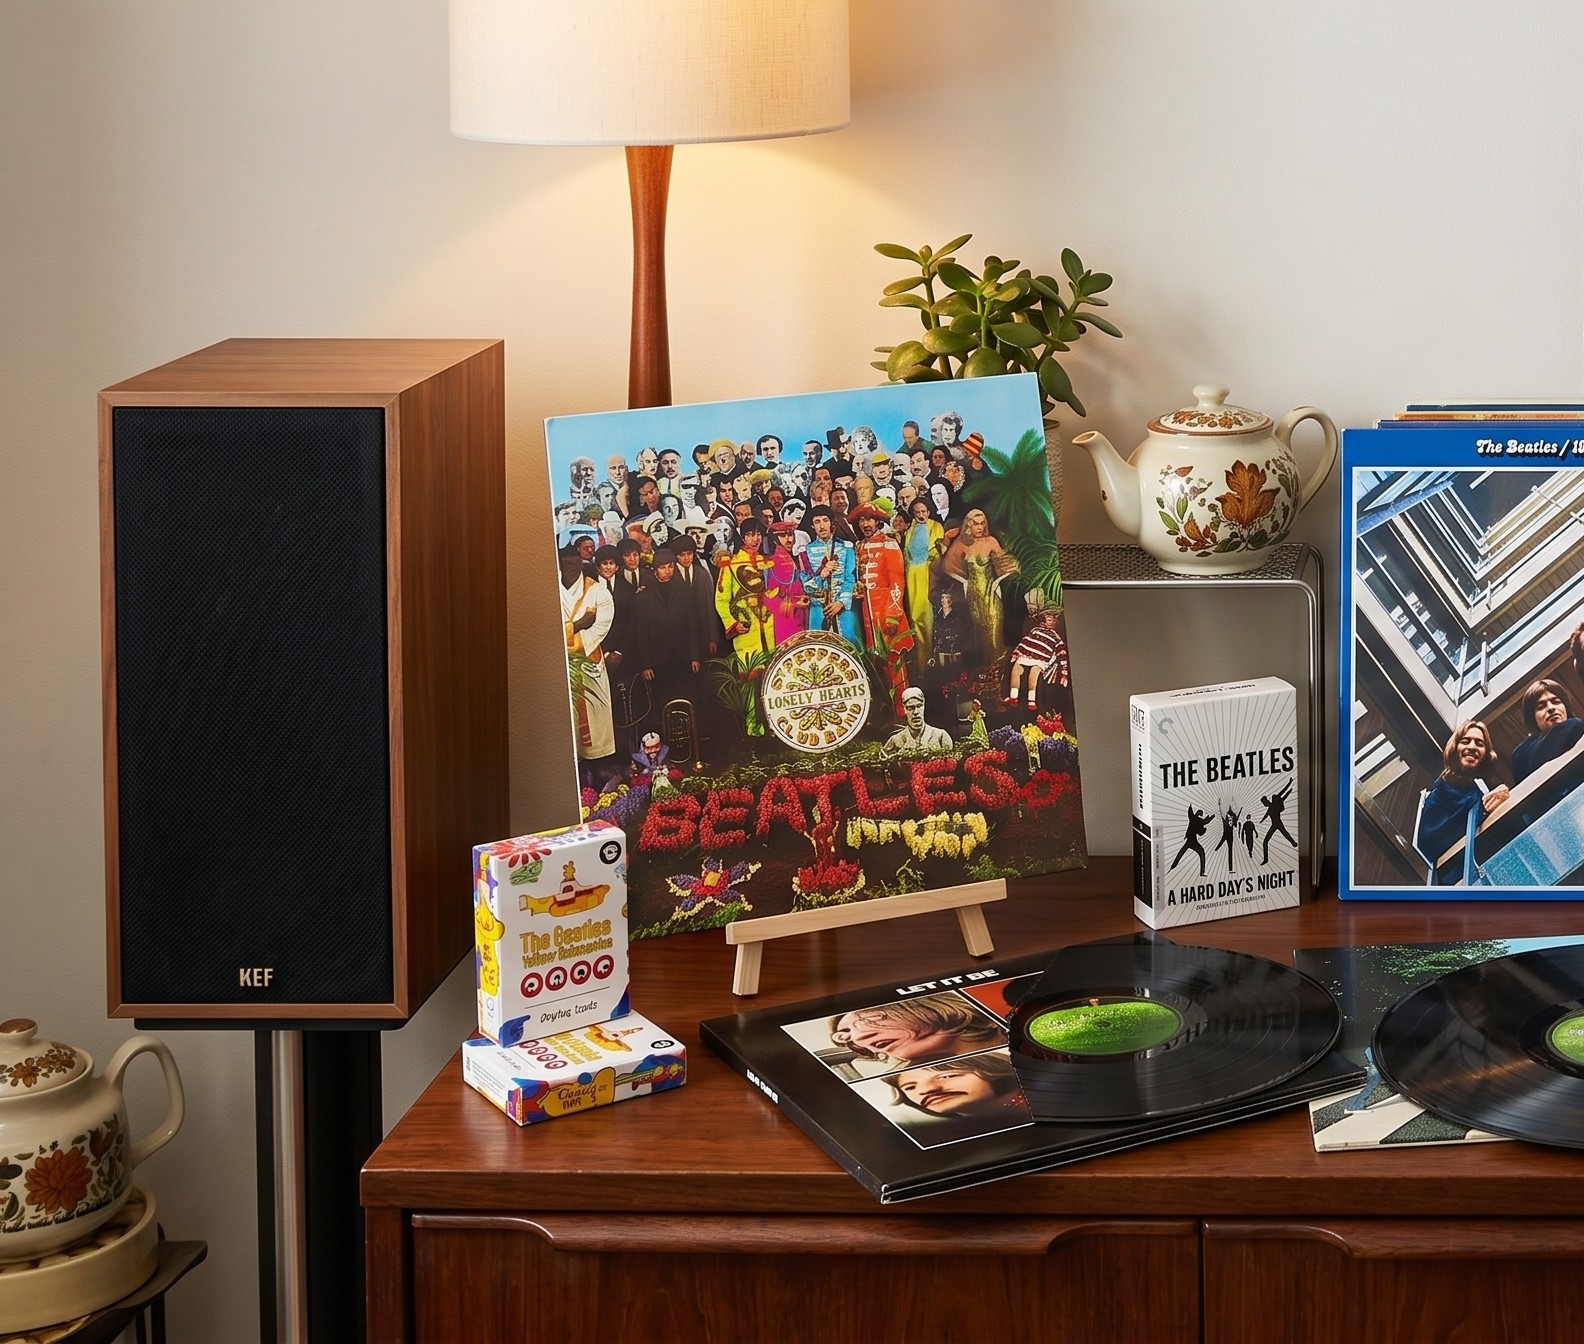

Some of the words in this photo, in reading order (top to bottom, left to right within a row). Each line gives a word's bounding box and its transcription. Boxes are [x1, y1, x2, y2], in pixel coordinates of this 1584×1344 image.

[1476, 439, 1502, 454] The
[1506, 439, 1558, 454] Beatles
[768, 691, 813, 710] LONELY
[820, 683, 866, 702] HEARTS
[1159, 759, 1199, 790] THE
[1206, 746, 1294, 783] BEATLES
[638, 750, 1018, 852] BEATLES
[1167, 889, 1177, 907] A
[1180, 883, 1214, 904] HARD
[1219, 876, 1254, 898] DAY'S
[1258, 870, 1295, 891] NIGHT
[240, 968, 274, 987] KEF
[896, 981, 937, 996] LET
[940, 975, 963, 986] IT
[965, 968, 1000, 981] BE
